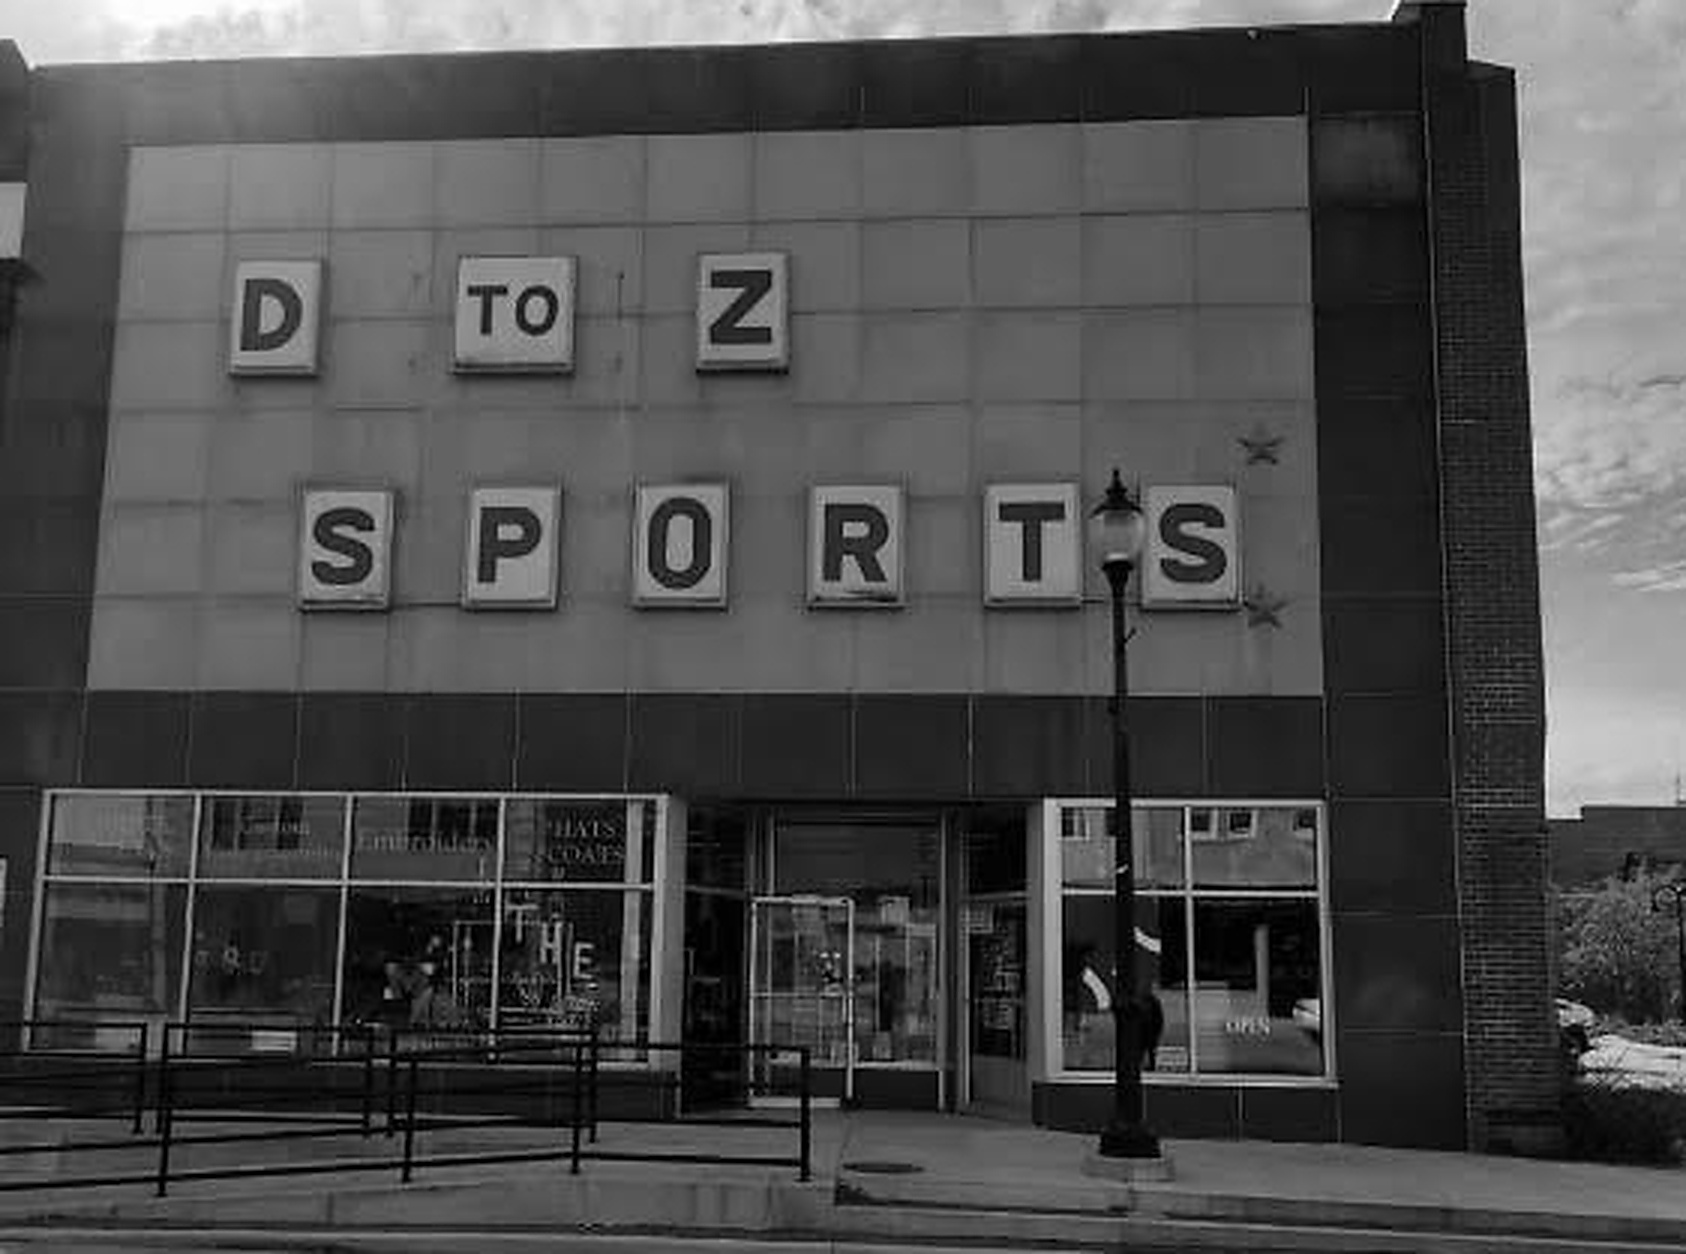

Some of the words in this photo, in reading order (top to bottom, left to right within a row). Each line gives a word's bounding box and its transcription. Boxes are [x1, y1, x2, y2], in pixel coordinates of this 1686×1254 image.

[240, 278, 304, 352] D
[467, 284, 559, 337] TO
[708, 269, 773, 345] Z
[310, 496, 1229, 590] SPORTS
